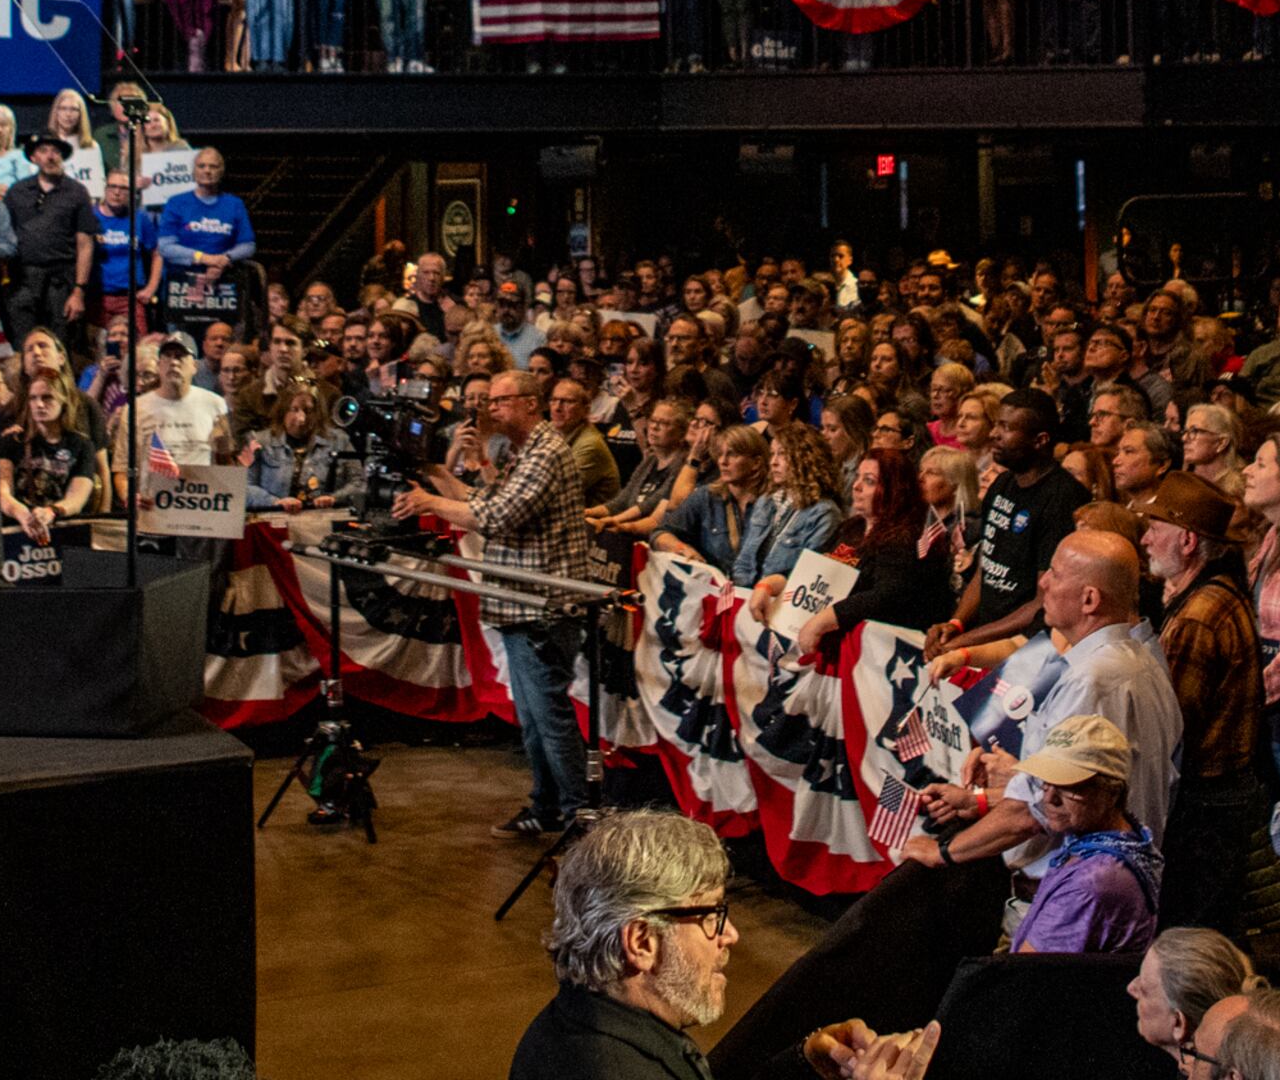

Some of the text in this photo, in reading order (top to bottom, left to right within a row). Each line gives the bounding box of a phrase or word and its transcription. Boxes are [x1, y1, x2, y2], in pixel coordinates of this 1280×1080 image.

[165, 162, 189, 174] Jon
[169, 294, 238, 311] REPUBLIC
[175, 478, 209, 495] Jon
[155, 489, 234, 512] Ossoff
[18, 545, 57, 563] Jon
